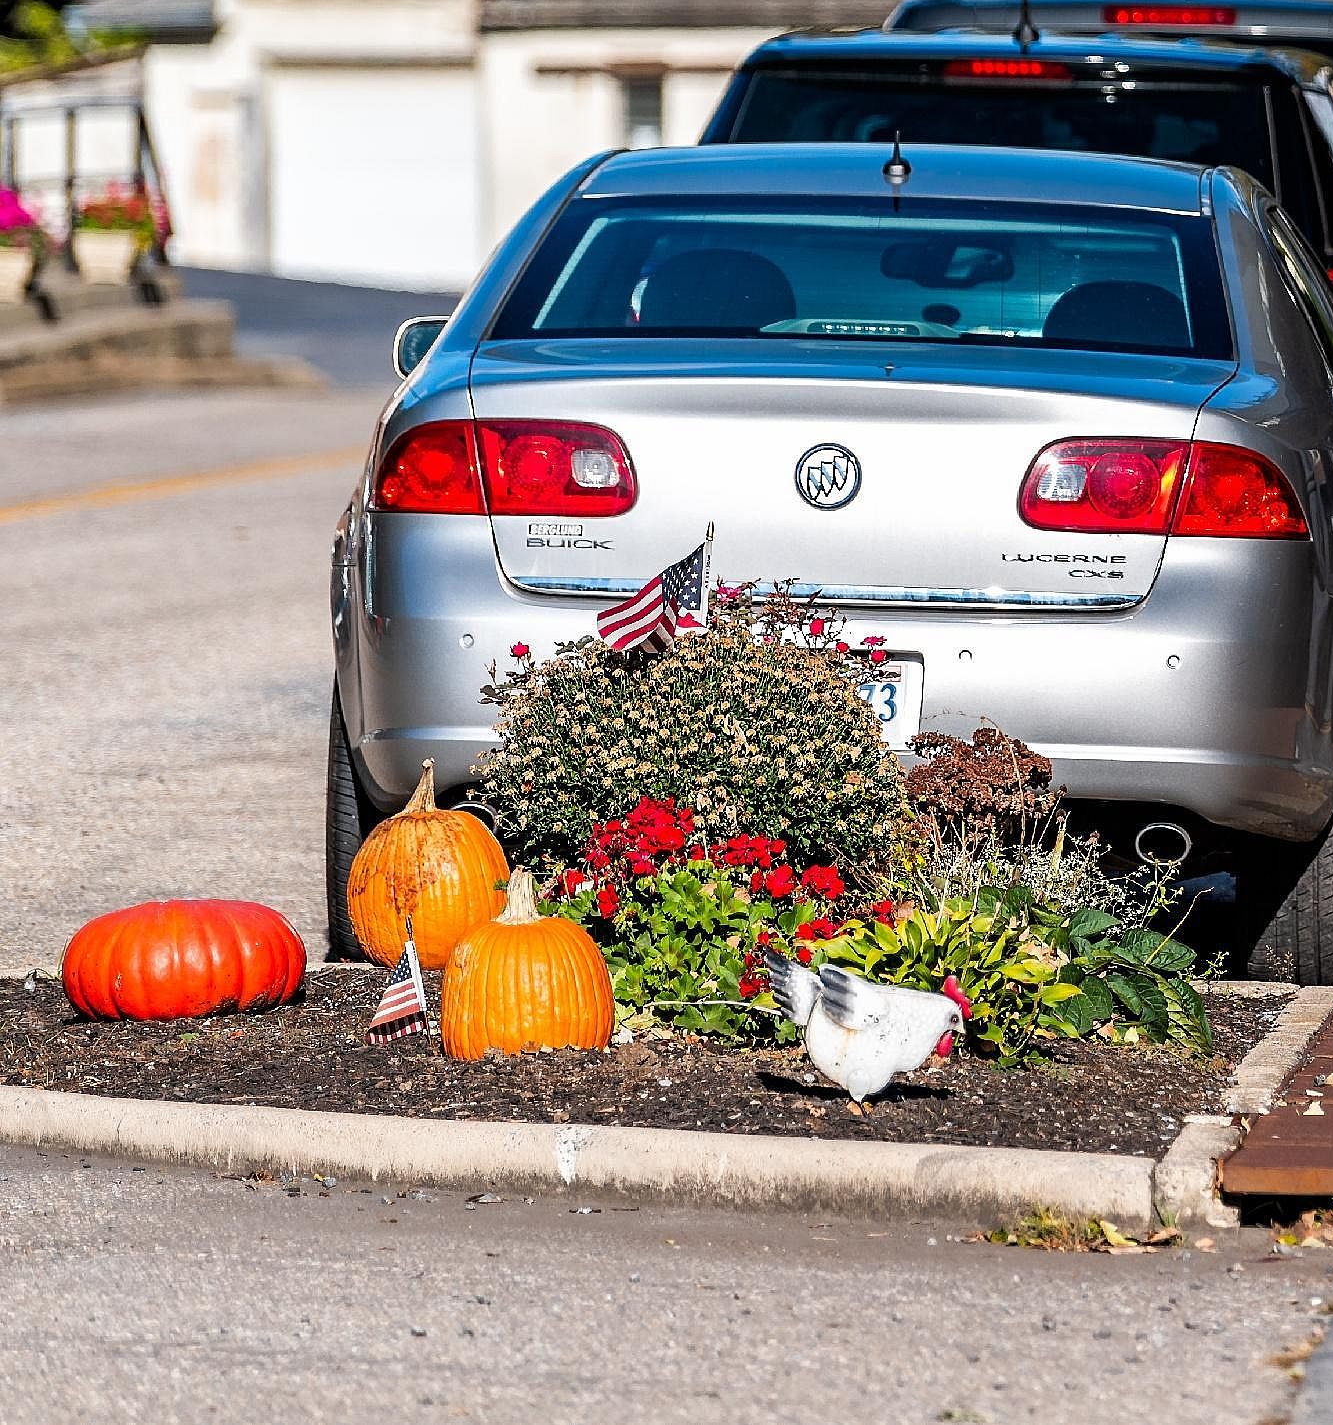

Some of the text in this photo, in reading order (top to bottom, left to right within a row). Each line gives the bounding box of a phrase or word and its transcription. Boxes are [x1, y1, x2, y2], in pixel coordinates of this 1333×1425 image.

[526, 538, 615, 550] BUICK
[1001, 553, 1127, 563] LUCERNE
[1068, 569, 1124, 579] CXS
